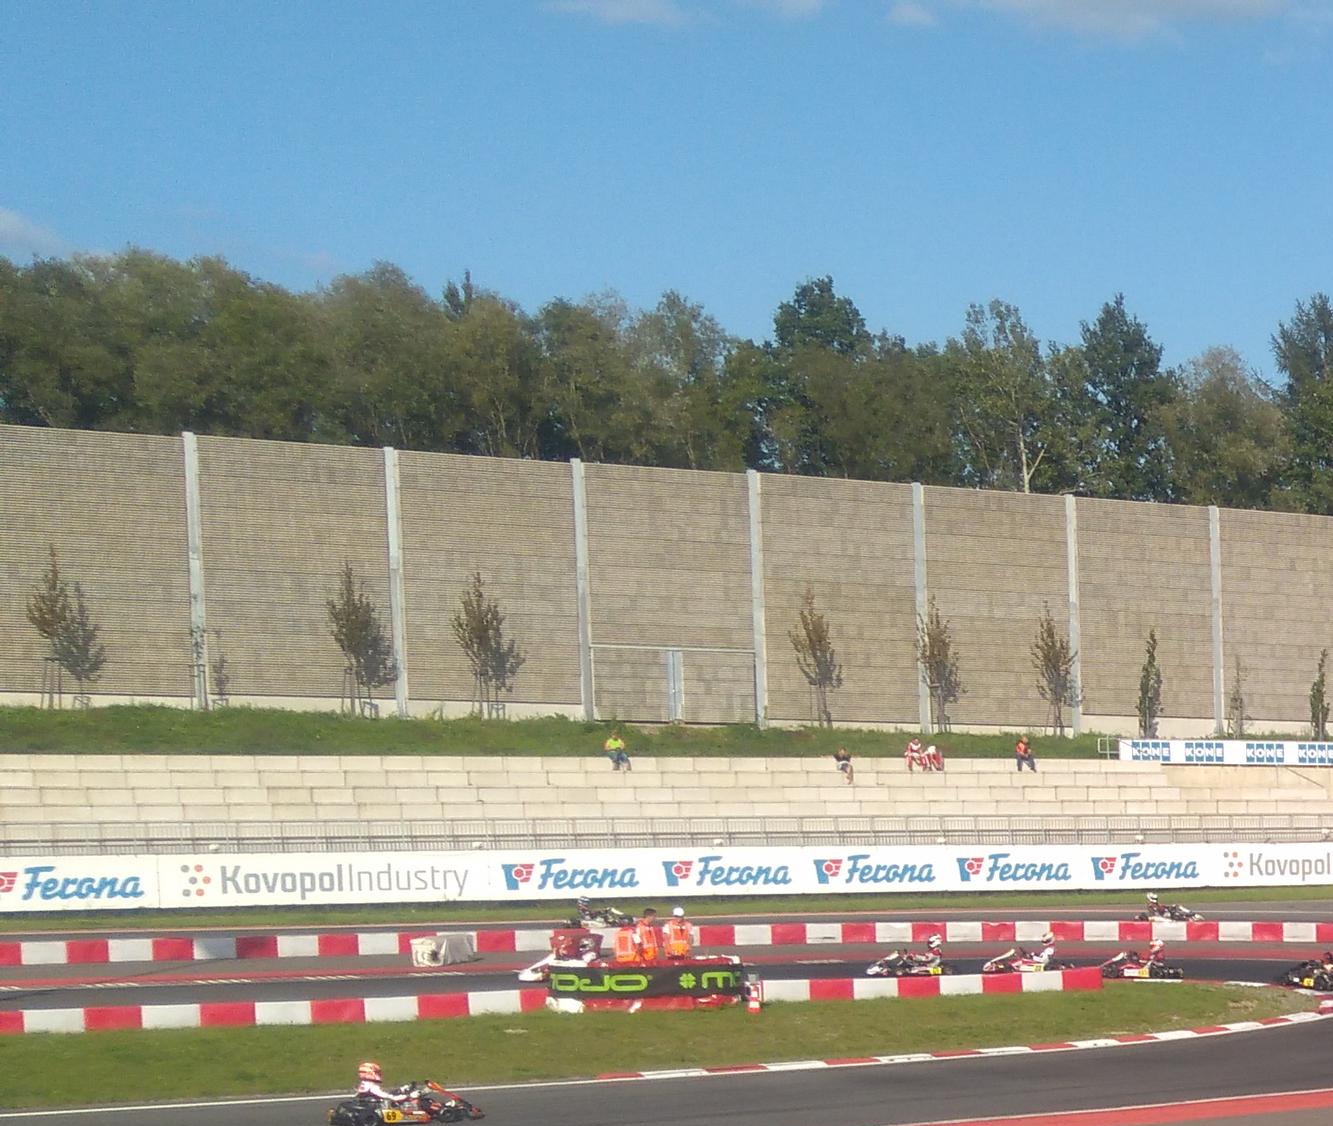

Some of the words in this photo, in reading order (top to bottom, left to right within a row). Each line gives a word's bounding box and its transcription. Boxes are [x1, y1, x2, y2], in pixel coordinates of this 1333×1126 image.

[1132, 742, 1171, 760] KONE
[1185, 742, 1224, 761] KONE
[1246, 743, 1284, 762] KONE
[538, 858, 640, 890] Ferona
[697, 856, 792, 886] Ferona
[845, 854, 936, 884] Ferona
[987, 853, 1072, 881] Ferona
[1119, 851, 1200, 880] Ferona
[23, 866, 144, 900] Ferona
